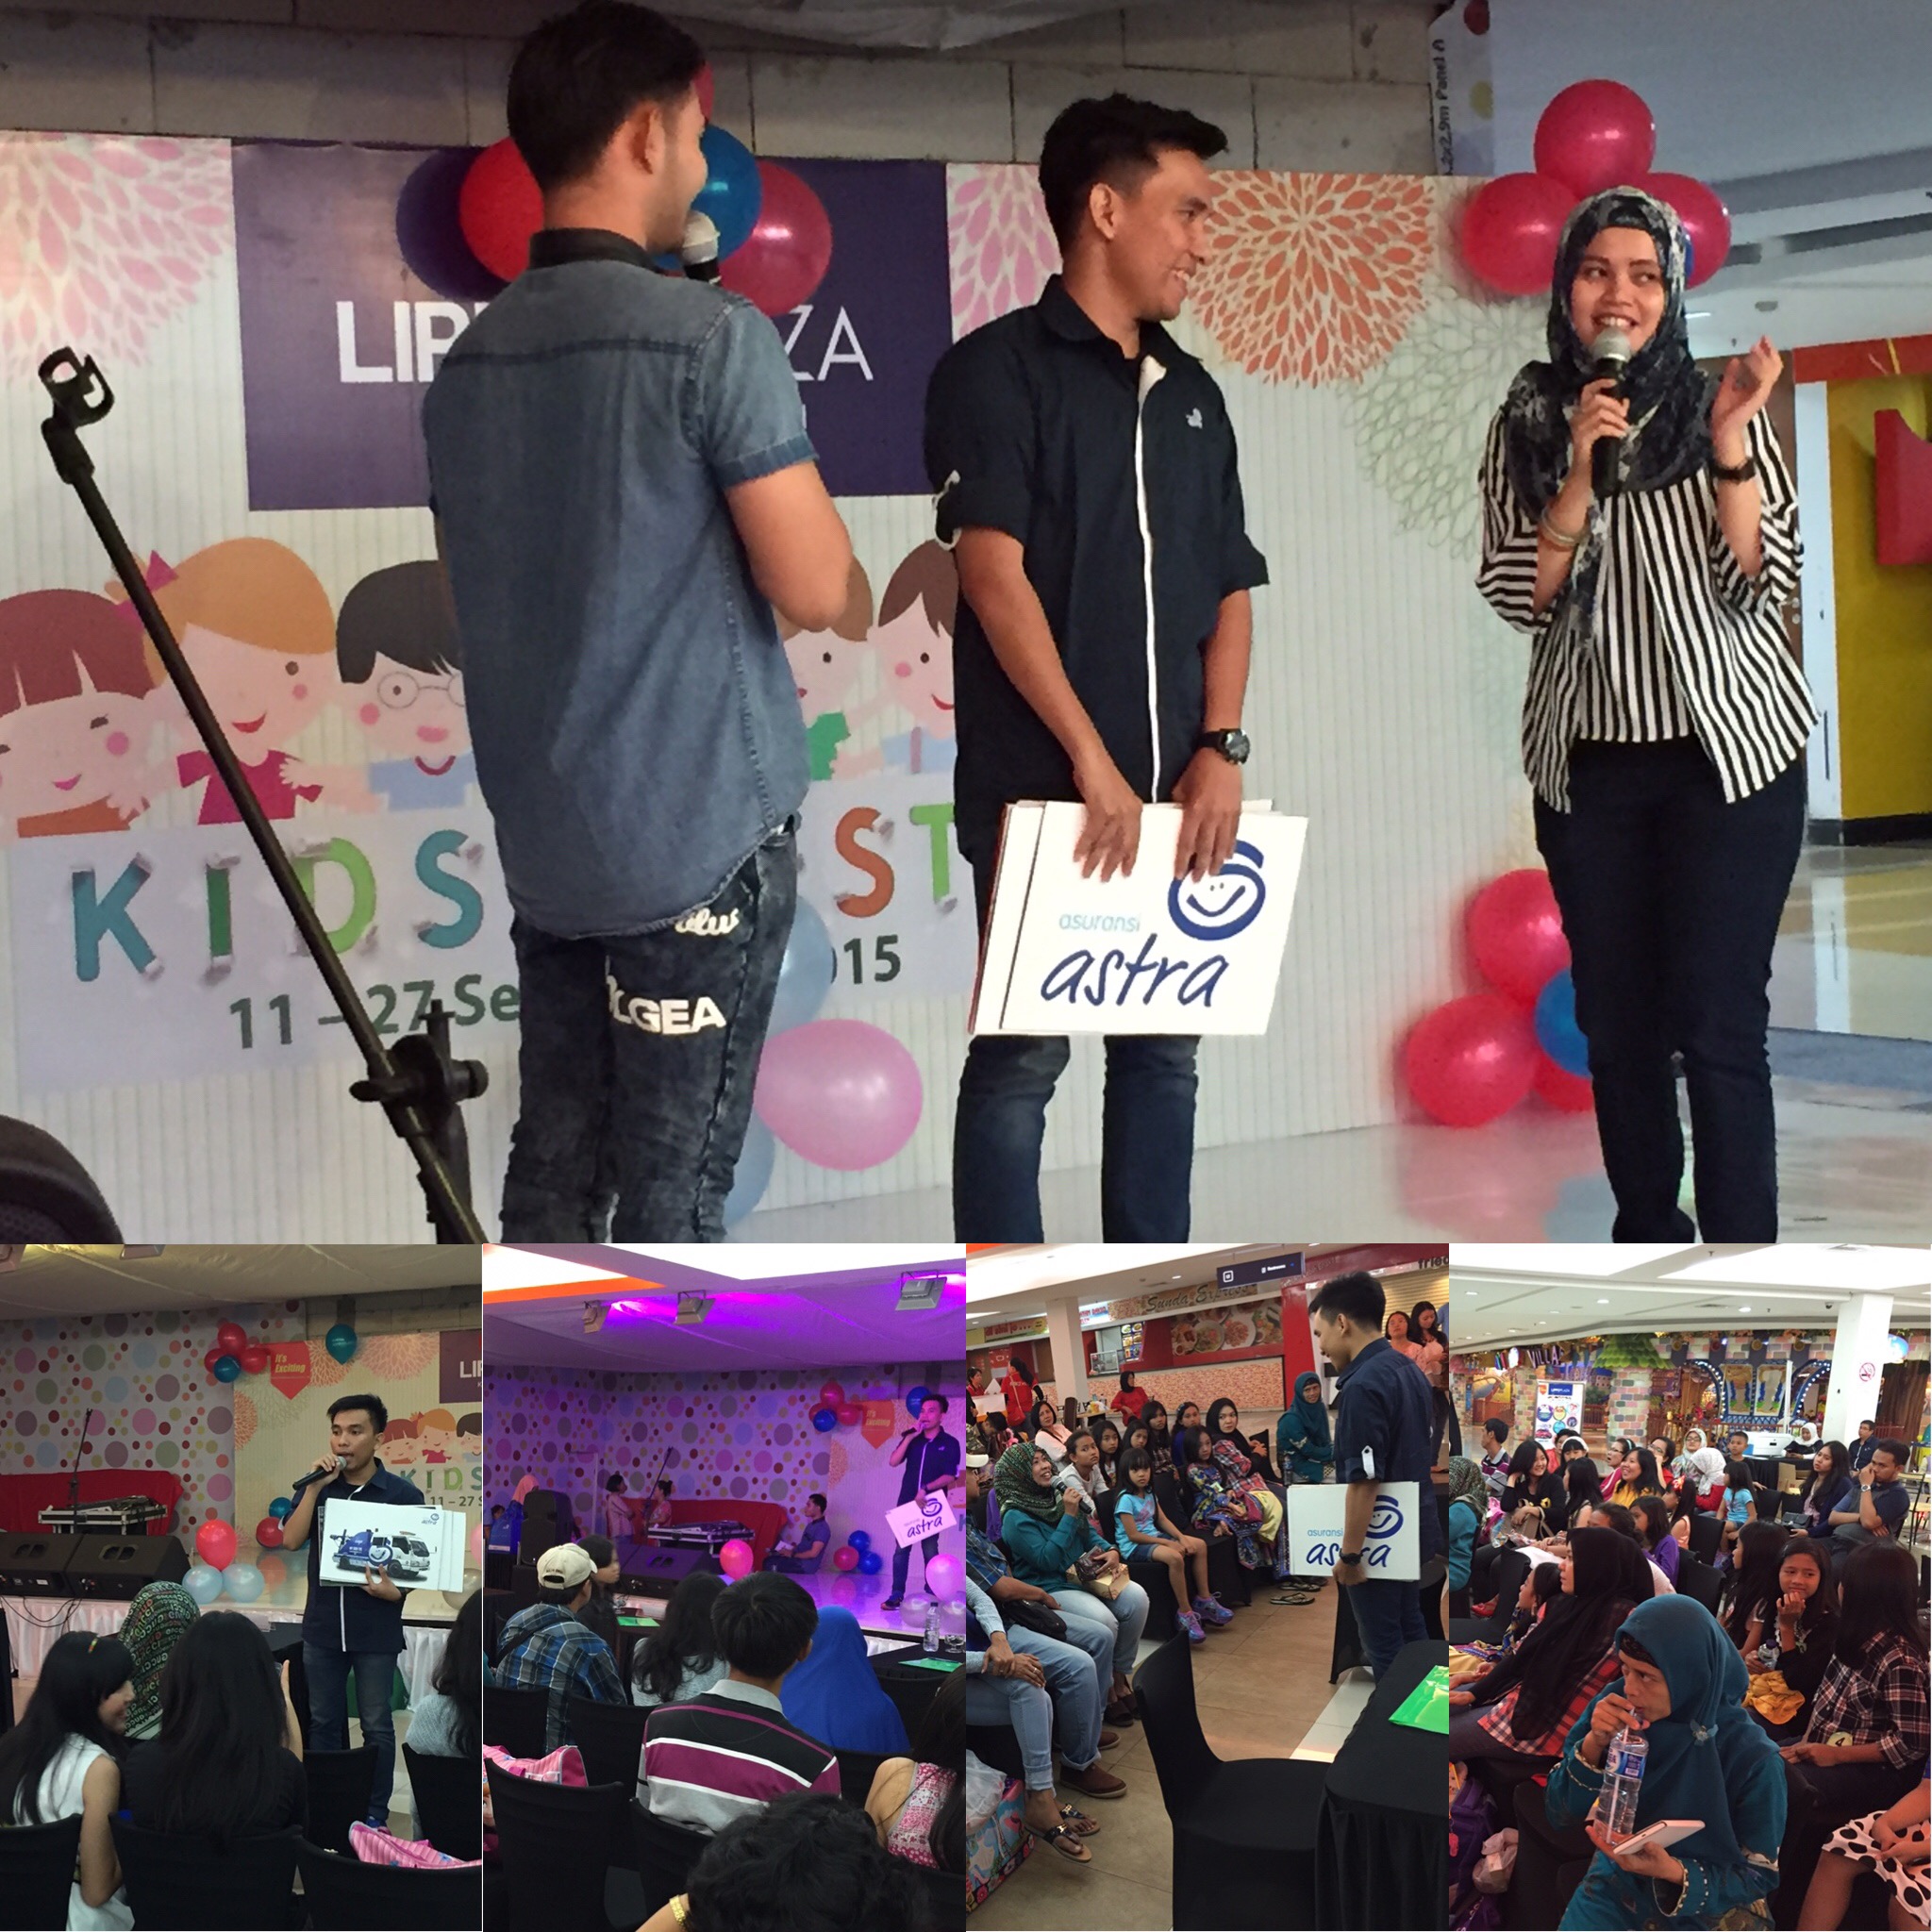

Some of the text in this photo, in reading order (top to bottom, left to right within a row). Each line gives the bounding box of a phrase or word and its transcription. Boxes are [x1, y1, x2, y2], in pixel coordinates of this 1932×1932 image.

[72, 829, 484, 982] KIDS
[1058, 910, 1141, 933] asuransi
[1040, 932, 1229, 1008] astra
[230, 994, 292, 1049] 11
[366, 979, 436, 1035] 27
[1146, 1291, 1189, 1312] Sunda
[458, 1495, 475, 1507] 27
[907, 1516, 943, 1539] astra
[1307, 1527, 1343, 1537] asuransi
[1306, 1542, 1392, 1568] asra
